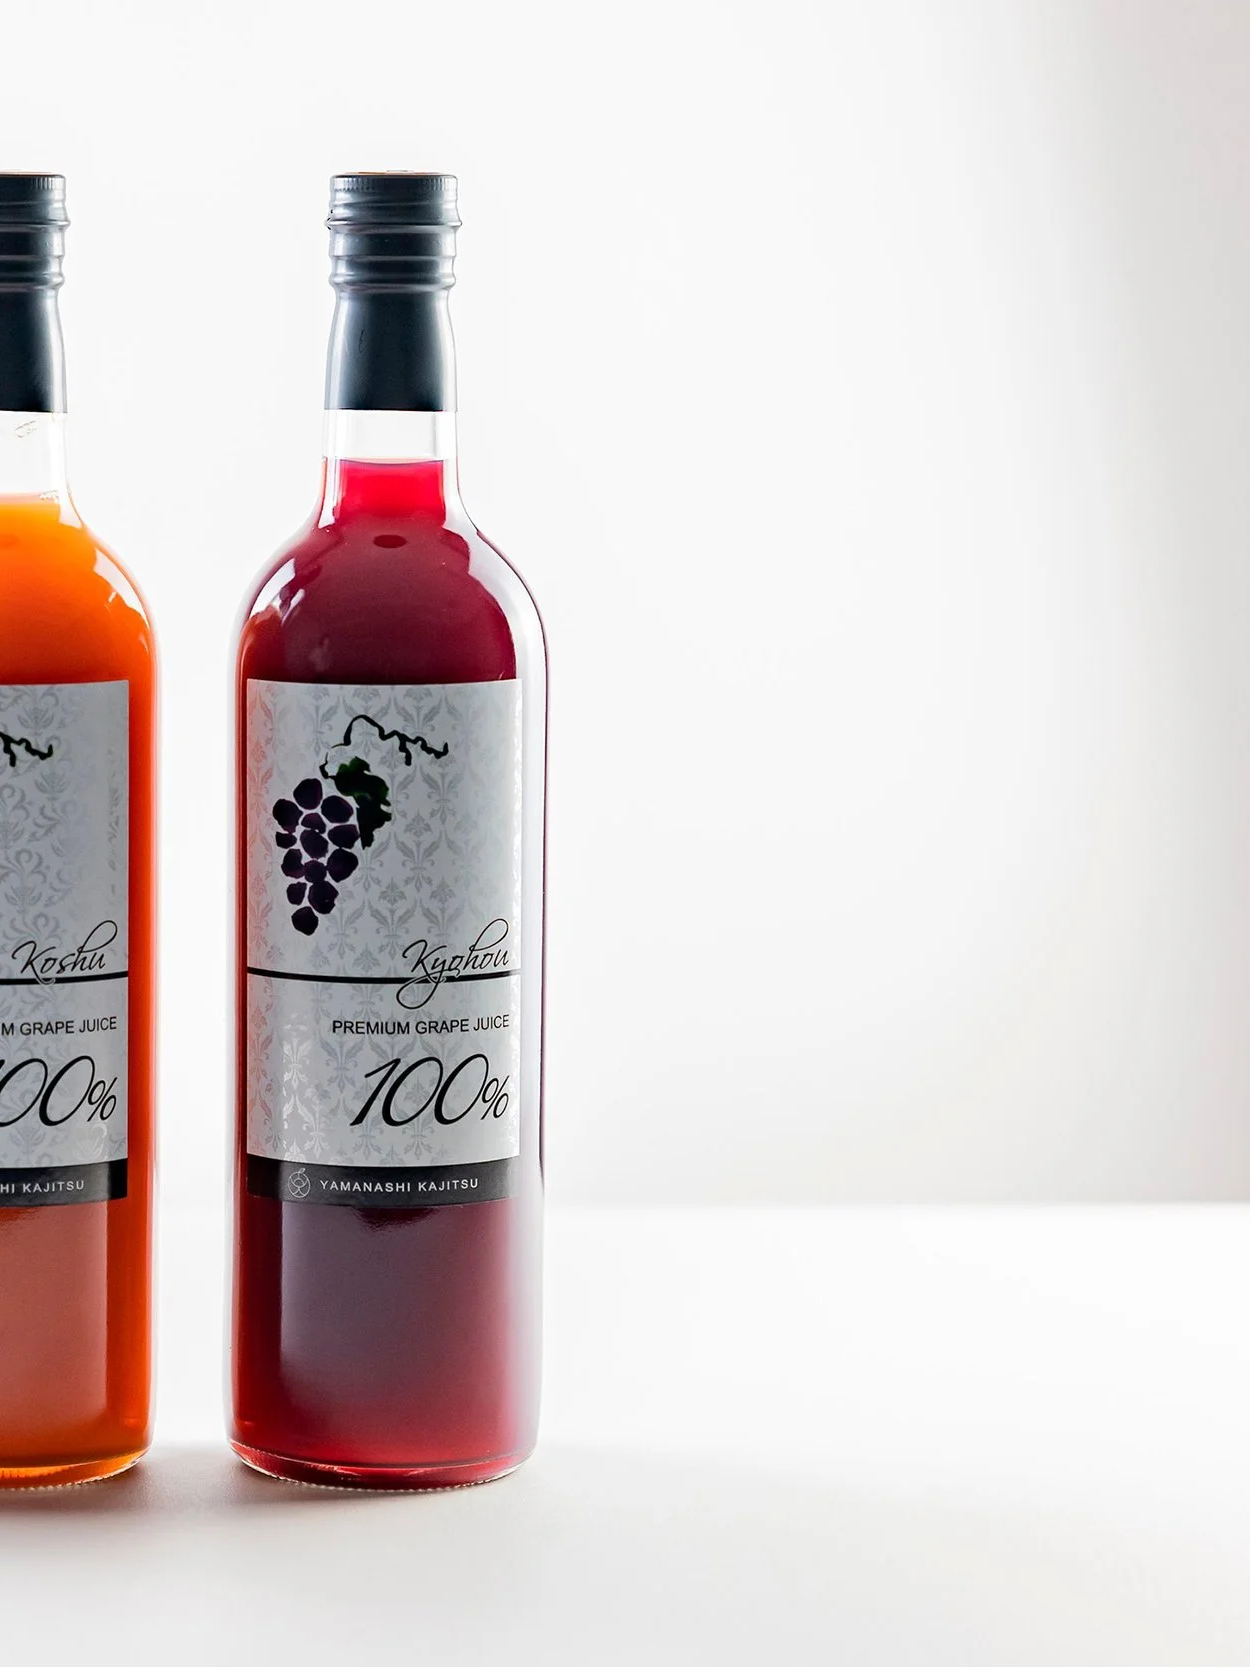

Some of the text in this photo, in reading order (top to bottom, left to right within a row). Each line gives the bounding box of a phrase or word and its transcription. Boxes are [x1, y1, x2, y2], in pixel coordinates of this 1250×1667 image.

[11, 920, 118, 985] Koshu
[396, 918, 510, 1009] Kyohou
[19, 1019, 74, 1036] GRAPE
[79, 1016, 117, 1033] JUICE
[332, 1014, 510, 1035] PREMIUM GRAPE JUICE
[350, 1053, 510, 1127] 100%
[22, 1179, 85, 1193] KAJITSU
[320, 1178, 479, 1193] YAMANASHI KAJITSU
